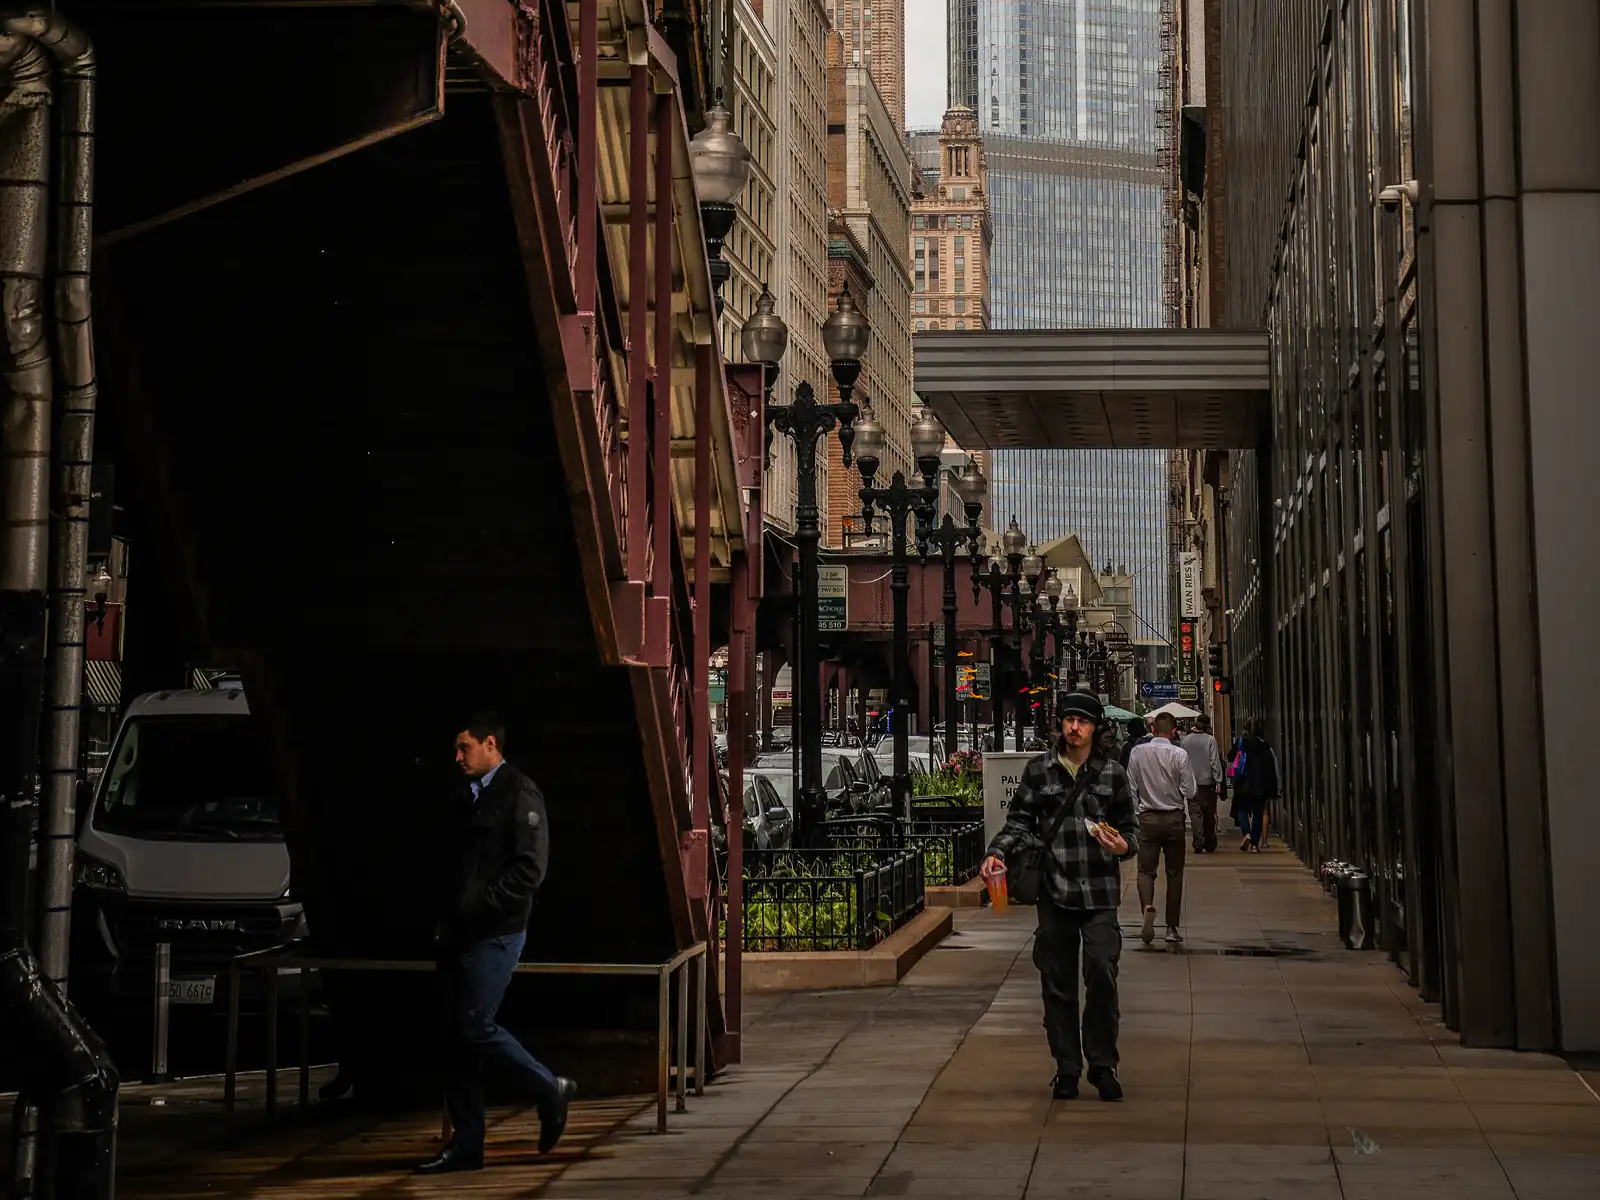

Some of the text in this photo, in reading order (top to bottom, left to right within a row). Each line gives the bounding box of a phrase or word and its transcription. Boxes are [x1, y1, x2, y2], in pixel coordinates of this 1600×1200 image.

[1184, 566, 1193, 588] RIES
[1185, 590, 1193, 615] IWAN
[159, 920, 236, 930] RAM
